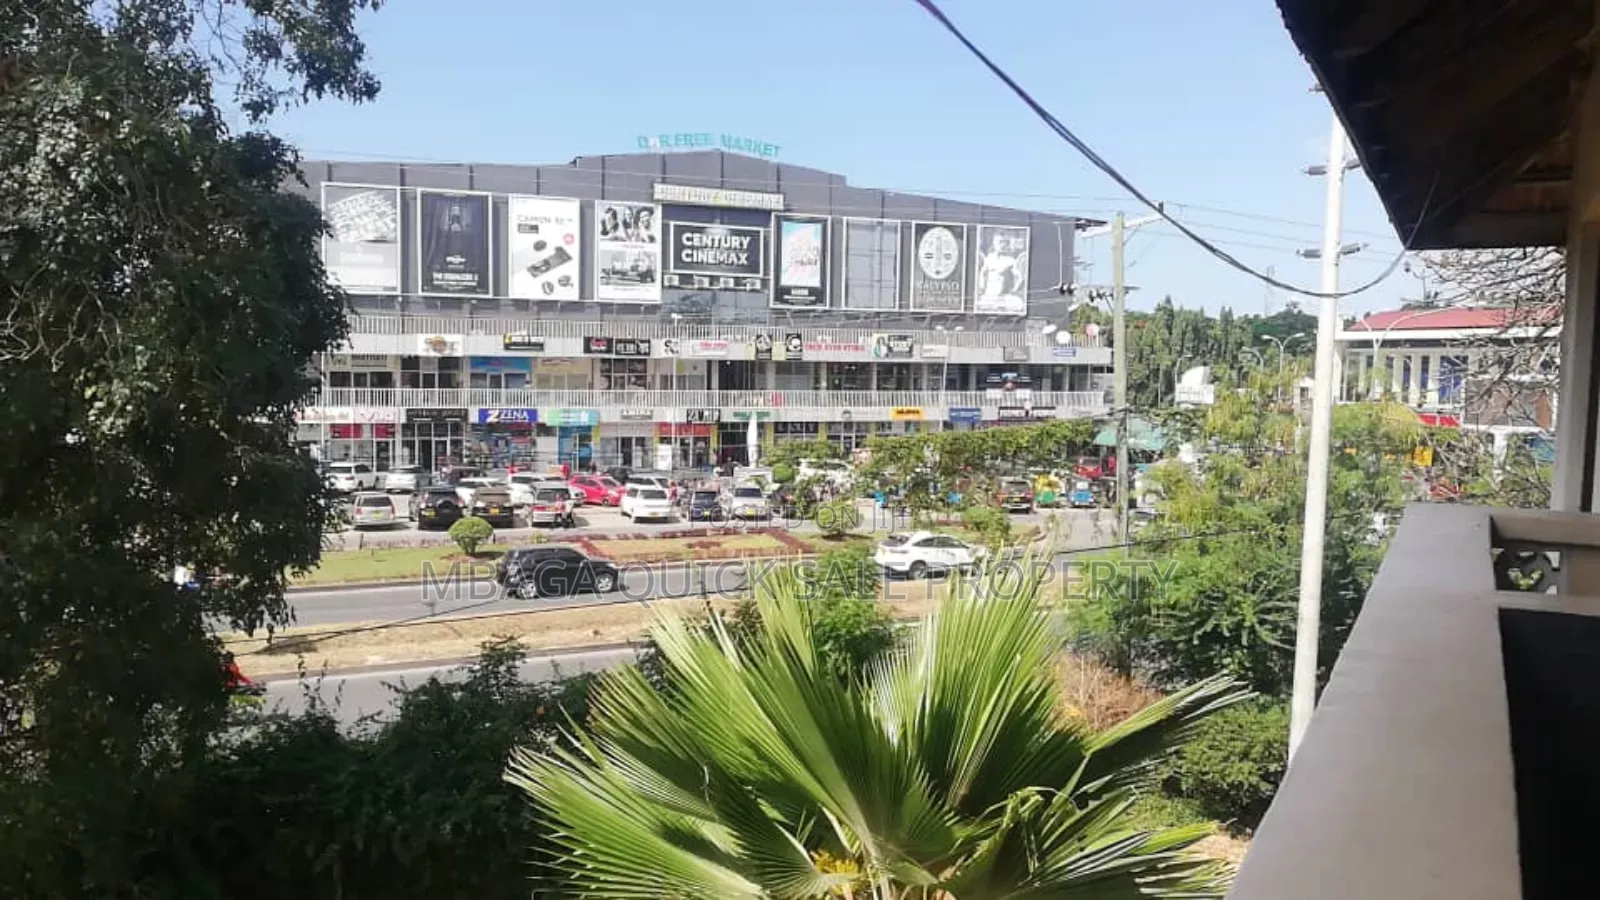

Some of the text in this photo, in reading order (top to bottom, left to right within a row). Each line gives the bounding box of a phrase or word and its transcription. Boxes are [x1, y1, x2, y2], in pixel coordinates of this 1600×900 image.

[674, 132, 713, 147] FREE
[720, 133, 782, 158] MARKET
[681, 232, 750, 249] CENTURY
[681, 248, 748, 265] CINEMAX
[500, 409, 530, 420] ZENA
